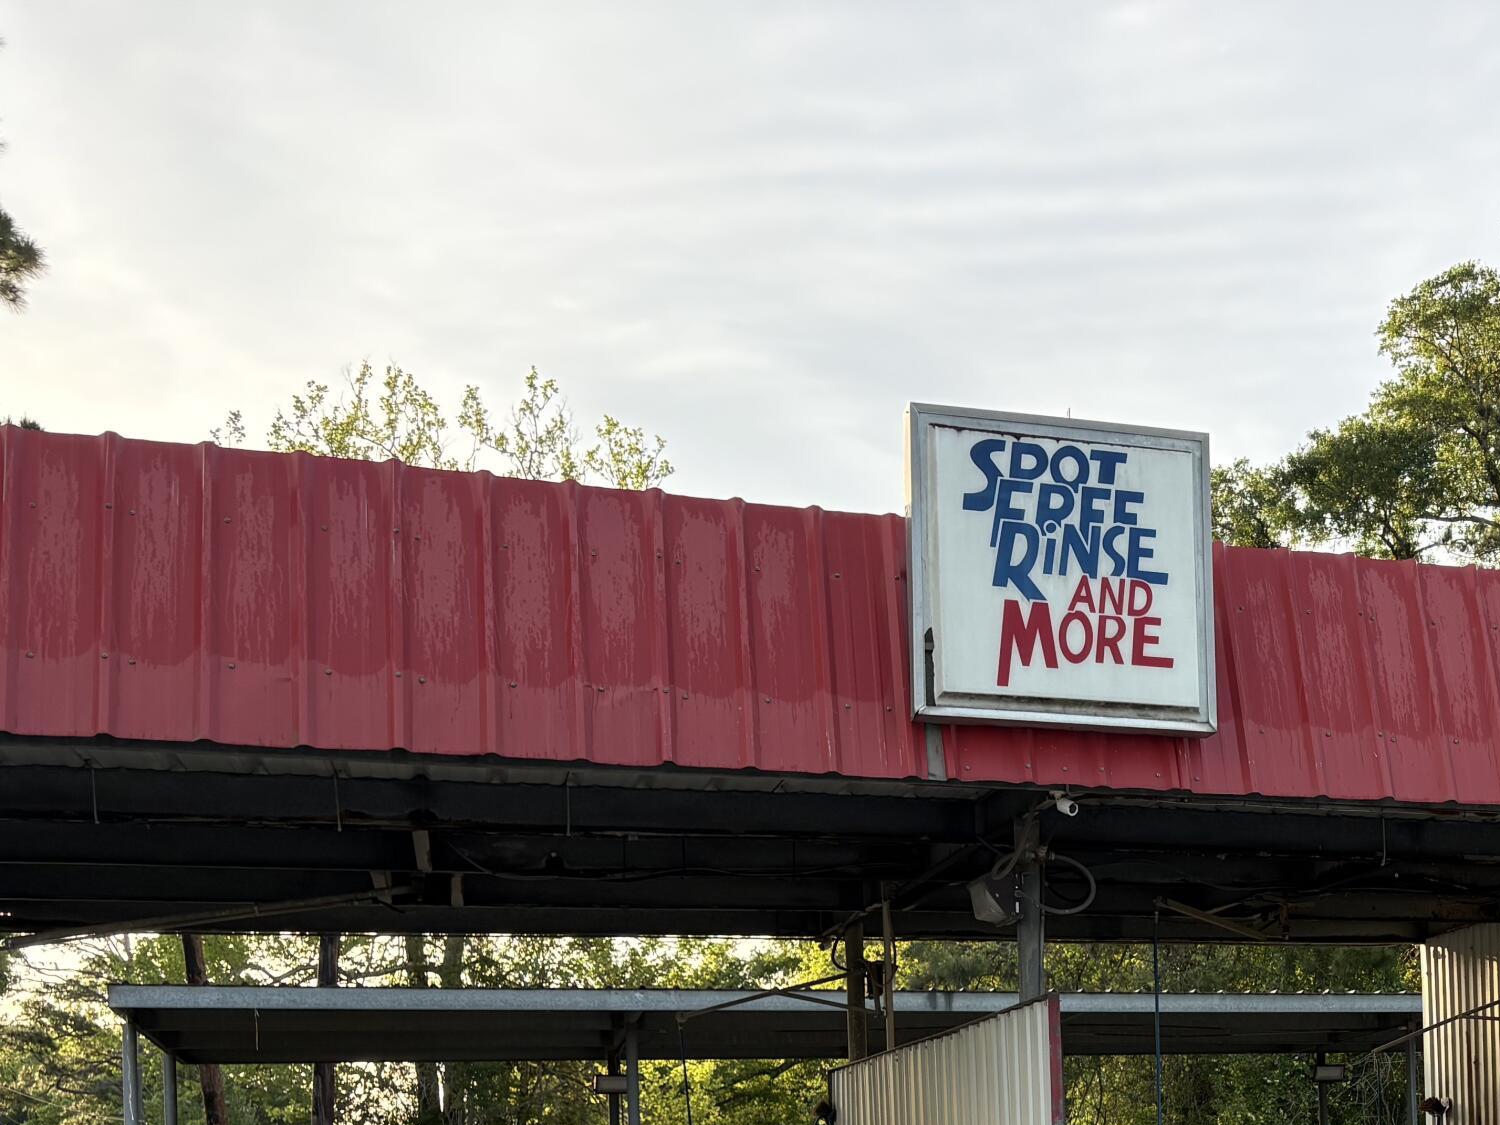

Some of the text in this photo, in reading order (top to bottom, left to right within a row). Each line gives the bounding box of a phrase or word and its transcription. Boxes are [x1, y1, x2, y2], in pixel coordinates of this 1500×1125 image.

[963, 439, 1127, 511] SPOT
[990, 479, 1144, 548] FREE
[1067, 575, 1153, 616] AND
[997, 599, 1174, 686] MORE
